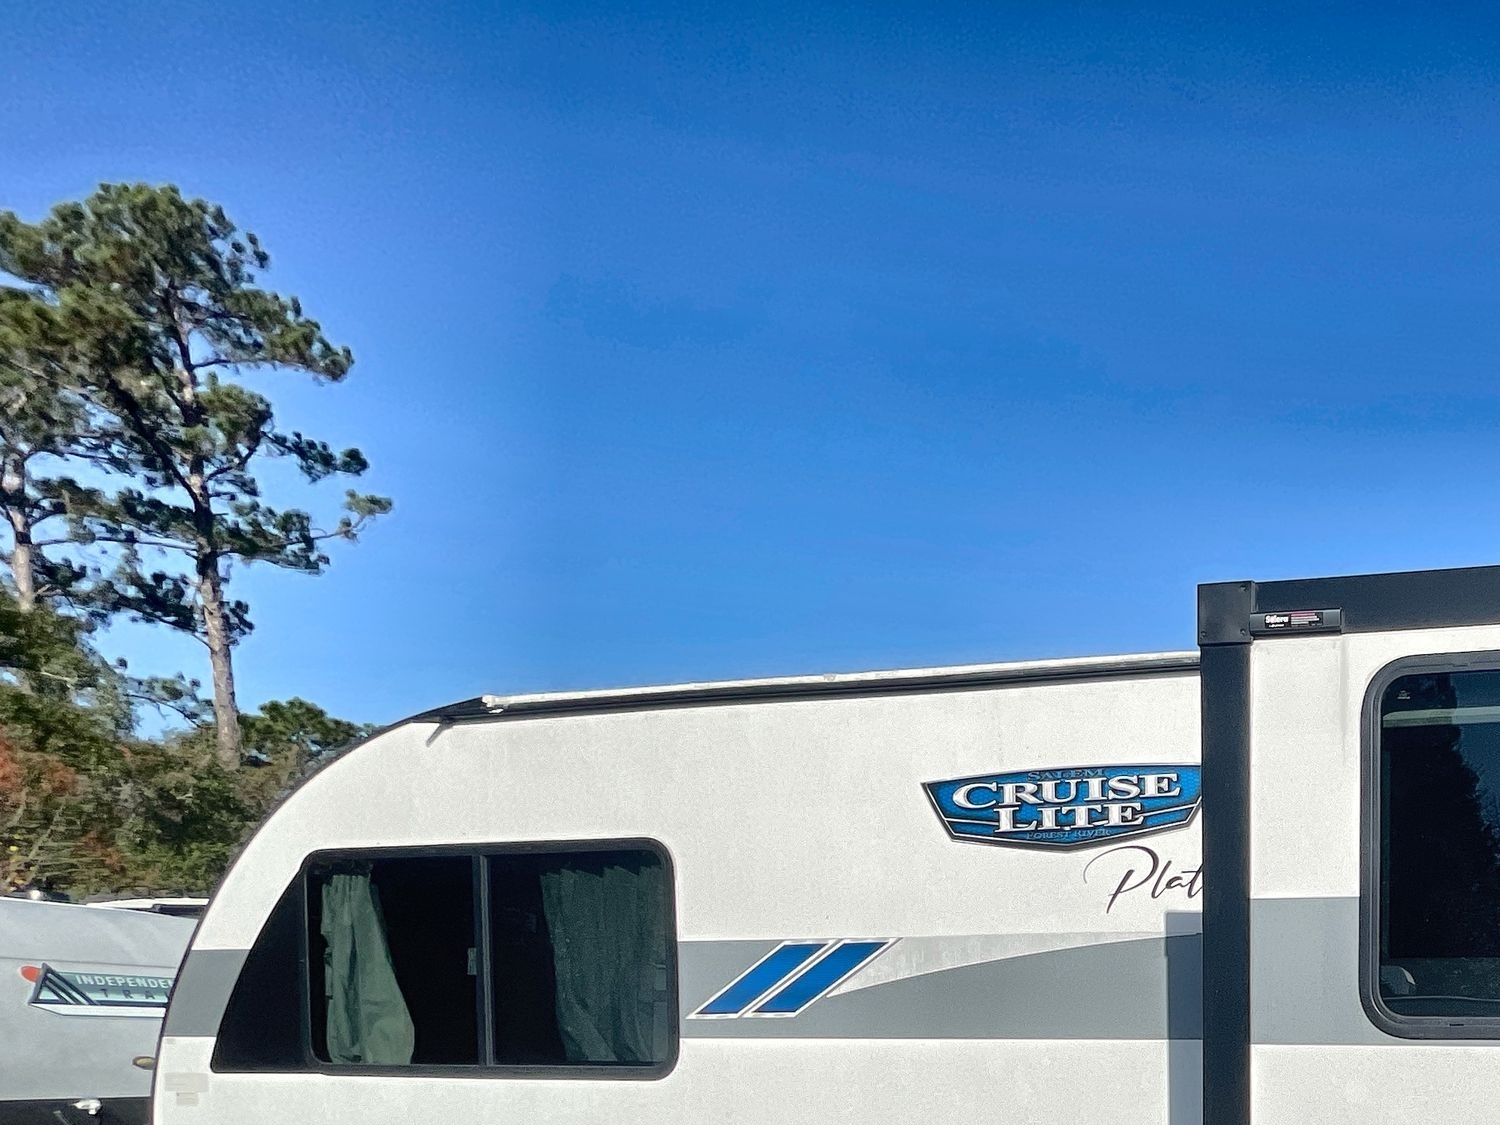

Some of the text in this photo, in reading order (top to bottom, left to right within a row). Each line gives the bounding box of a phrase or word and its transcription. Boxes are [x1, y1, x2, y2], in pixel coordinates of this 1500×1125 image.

[1027, 768, 1105, 780] SALEM
[952, 773, 1181, 809] CRUISE
[994, 803, 1145, 833] LITE
[1026, 826, 1112, 840] FOREST RIVER
